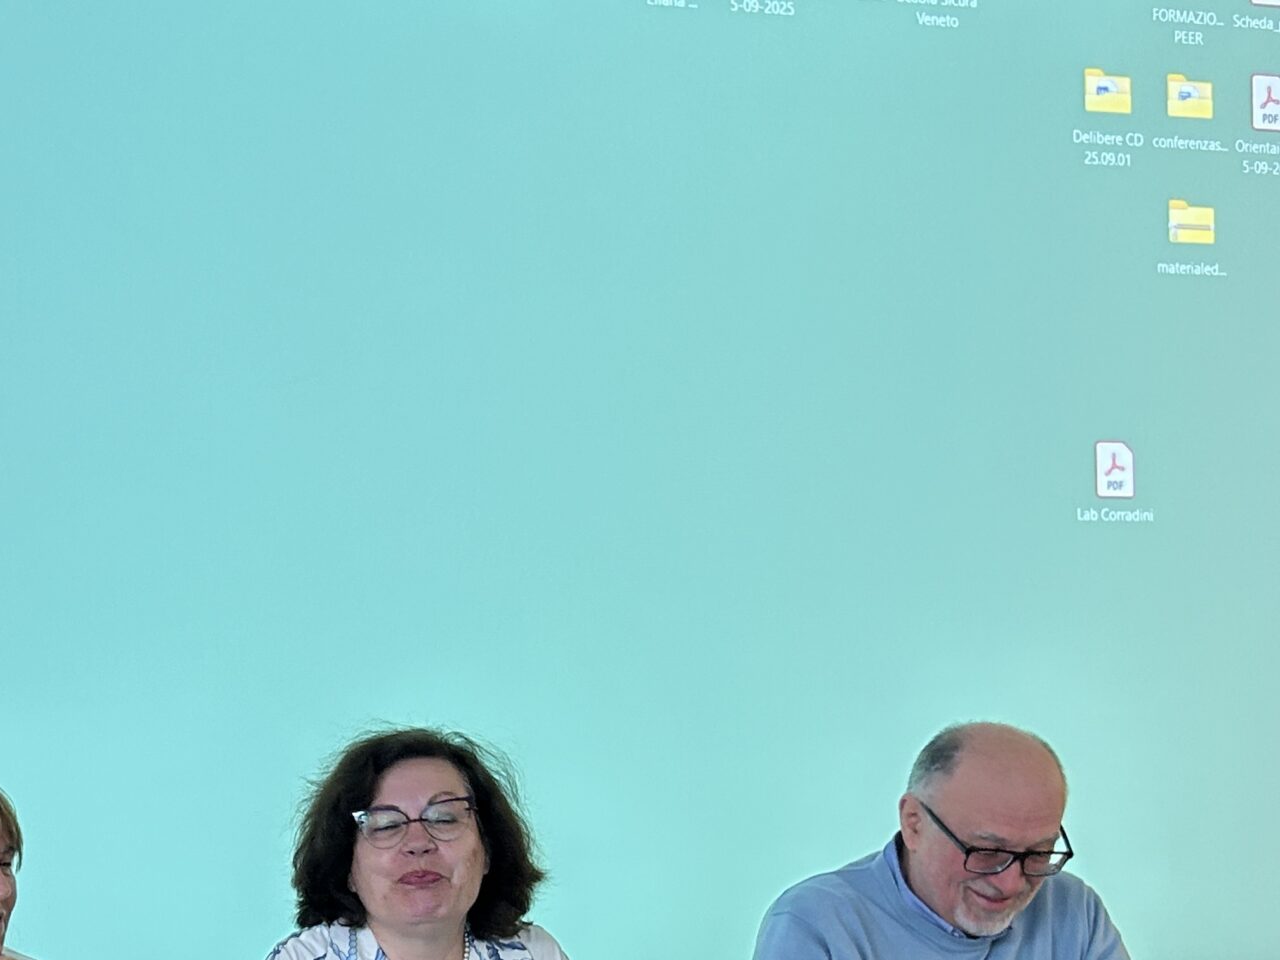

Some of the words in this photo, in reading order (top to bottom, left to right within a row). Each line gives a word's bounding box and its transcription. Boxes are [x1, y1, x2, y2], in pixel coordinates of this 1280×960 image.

[730, 0, 795, 16] 5-09-2025
[916, 11, 959, 28] Veneto
[1232, 14, 1280, 33] Scheda_
[1174, 30, 1204, 46] PEER
[1072, 129, 1124, 146] Delibere
[1125, 132, 1144, 147] CD
[1084, 151, 1131, 167] 25.09.01
[1077, 507, 1098, 521] Lab
[1100, 507, 1154, 522] Corradini
